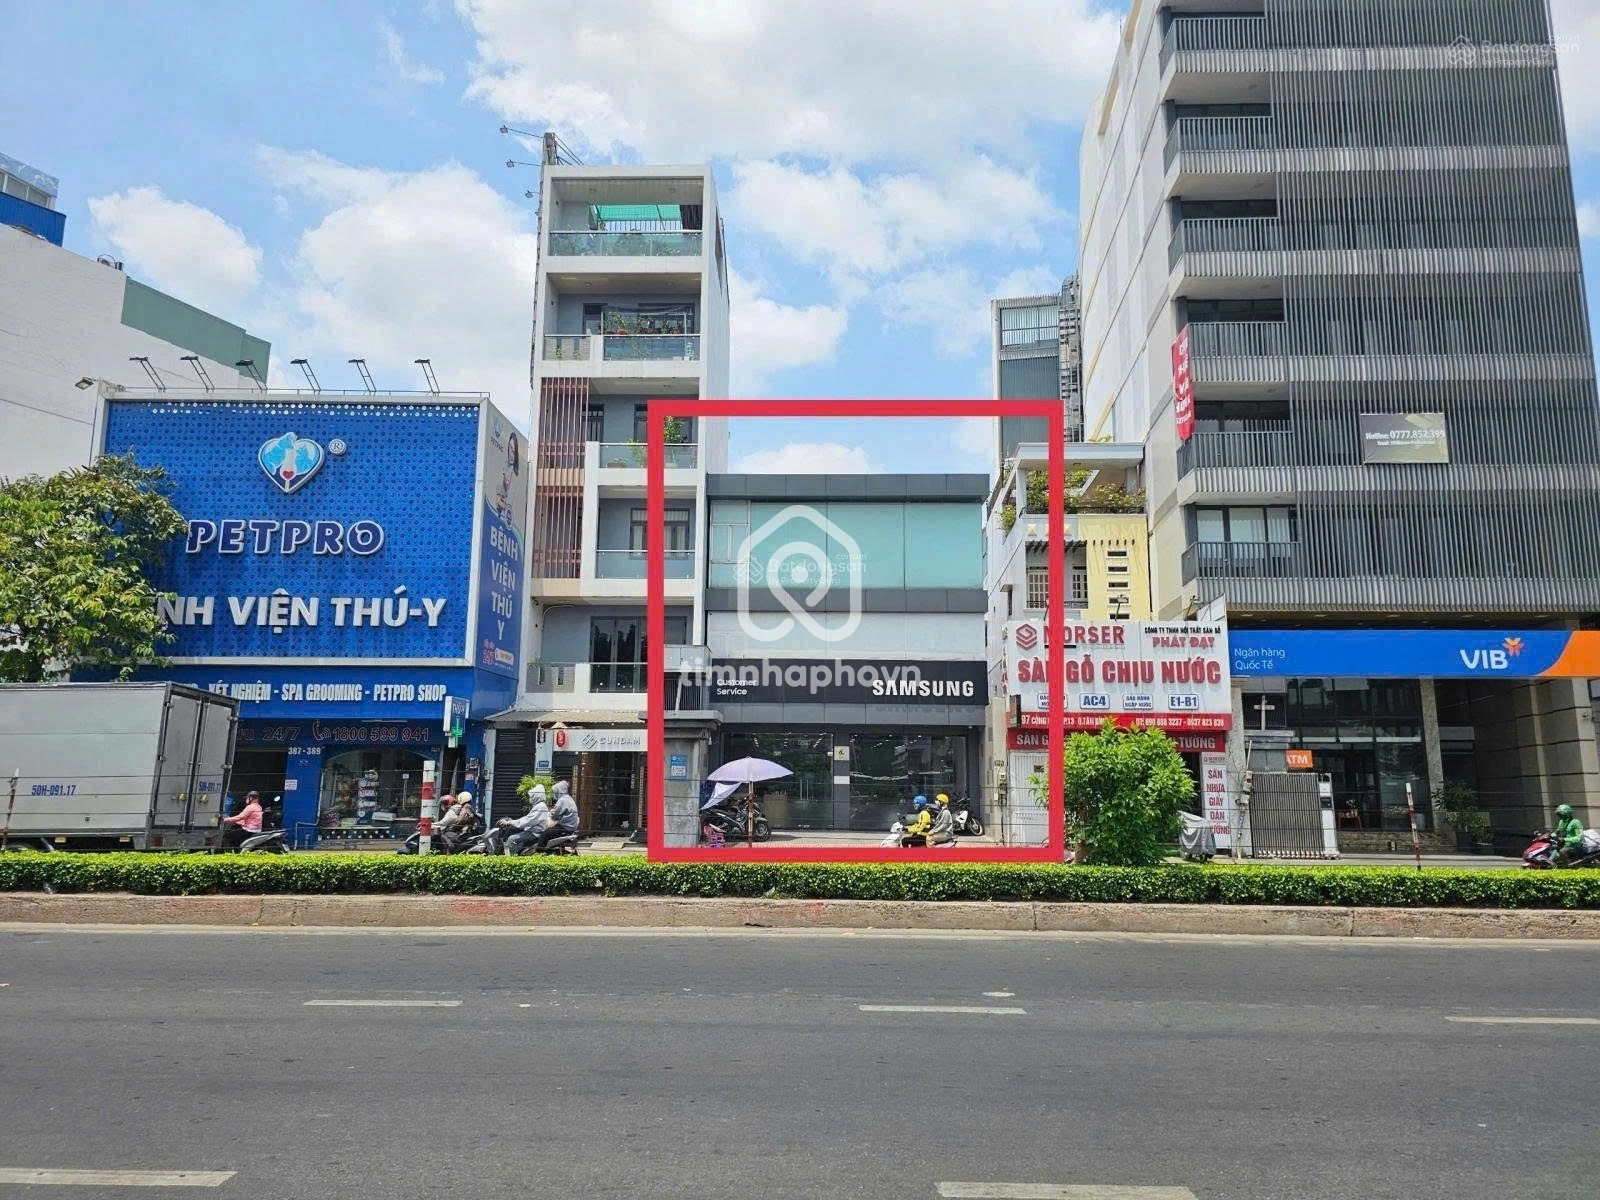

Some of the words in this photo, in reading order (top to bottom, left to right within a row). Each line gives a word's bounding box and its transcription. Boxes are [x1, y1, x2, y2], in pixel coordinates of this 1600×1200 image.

[185, 519, 384, 555] PETPRO
[490, 526, 518, 562] BỆNH
[491, 558, 516, 592] VIỆN
[228, 588, 319, 634] VIỆN
[330, 585, 447, 627] THÚ-Y
[491, 591, 513, 618] THÚ
[497, 620, 505, 641] Y
[1043, 625, 1124, 644] ORSER
[1234, 648, 1259, 659] Ngân
[1261, 648, 1286, 659] hàng
[1460, 649, 1508, 670] VIB
[1066, 654, 1094, 683] GỖ
[1102, 660, 1154, 687] CHỊU
[1161, 656, 1221, 684] NƯỚC
[1235, 659, 1260, 670] Quốc
[1261, 659, 1273, 670] Tế
[231, 680, 271, 703] NGHIỆM
[281, 683, 303, 701] SPA
[305, 683, 362, 701] GROOMING
[373, 684, 415, 701] PETPRO
[418, 684, 447, 701] SHOP
[716, 678, 758, 687] Customer
[716, 687, 748, 695] Service
[872, 679, 975, 697] SAMSUNG
[1083, 695, 1107, 707] AC4
[1170, 696, 1197, 707] E1-B1
[333, 726, 367, 741] 1800
[370, 726, 399, 741] 599
[402, 727, 429, 741] 941
[31, 784, 76, 797] 50H-091.17
